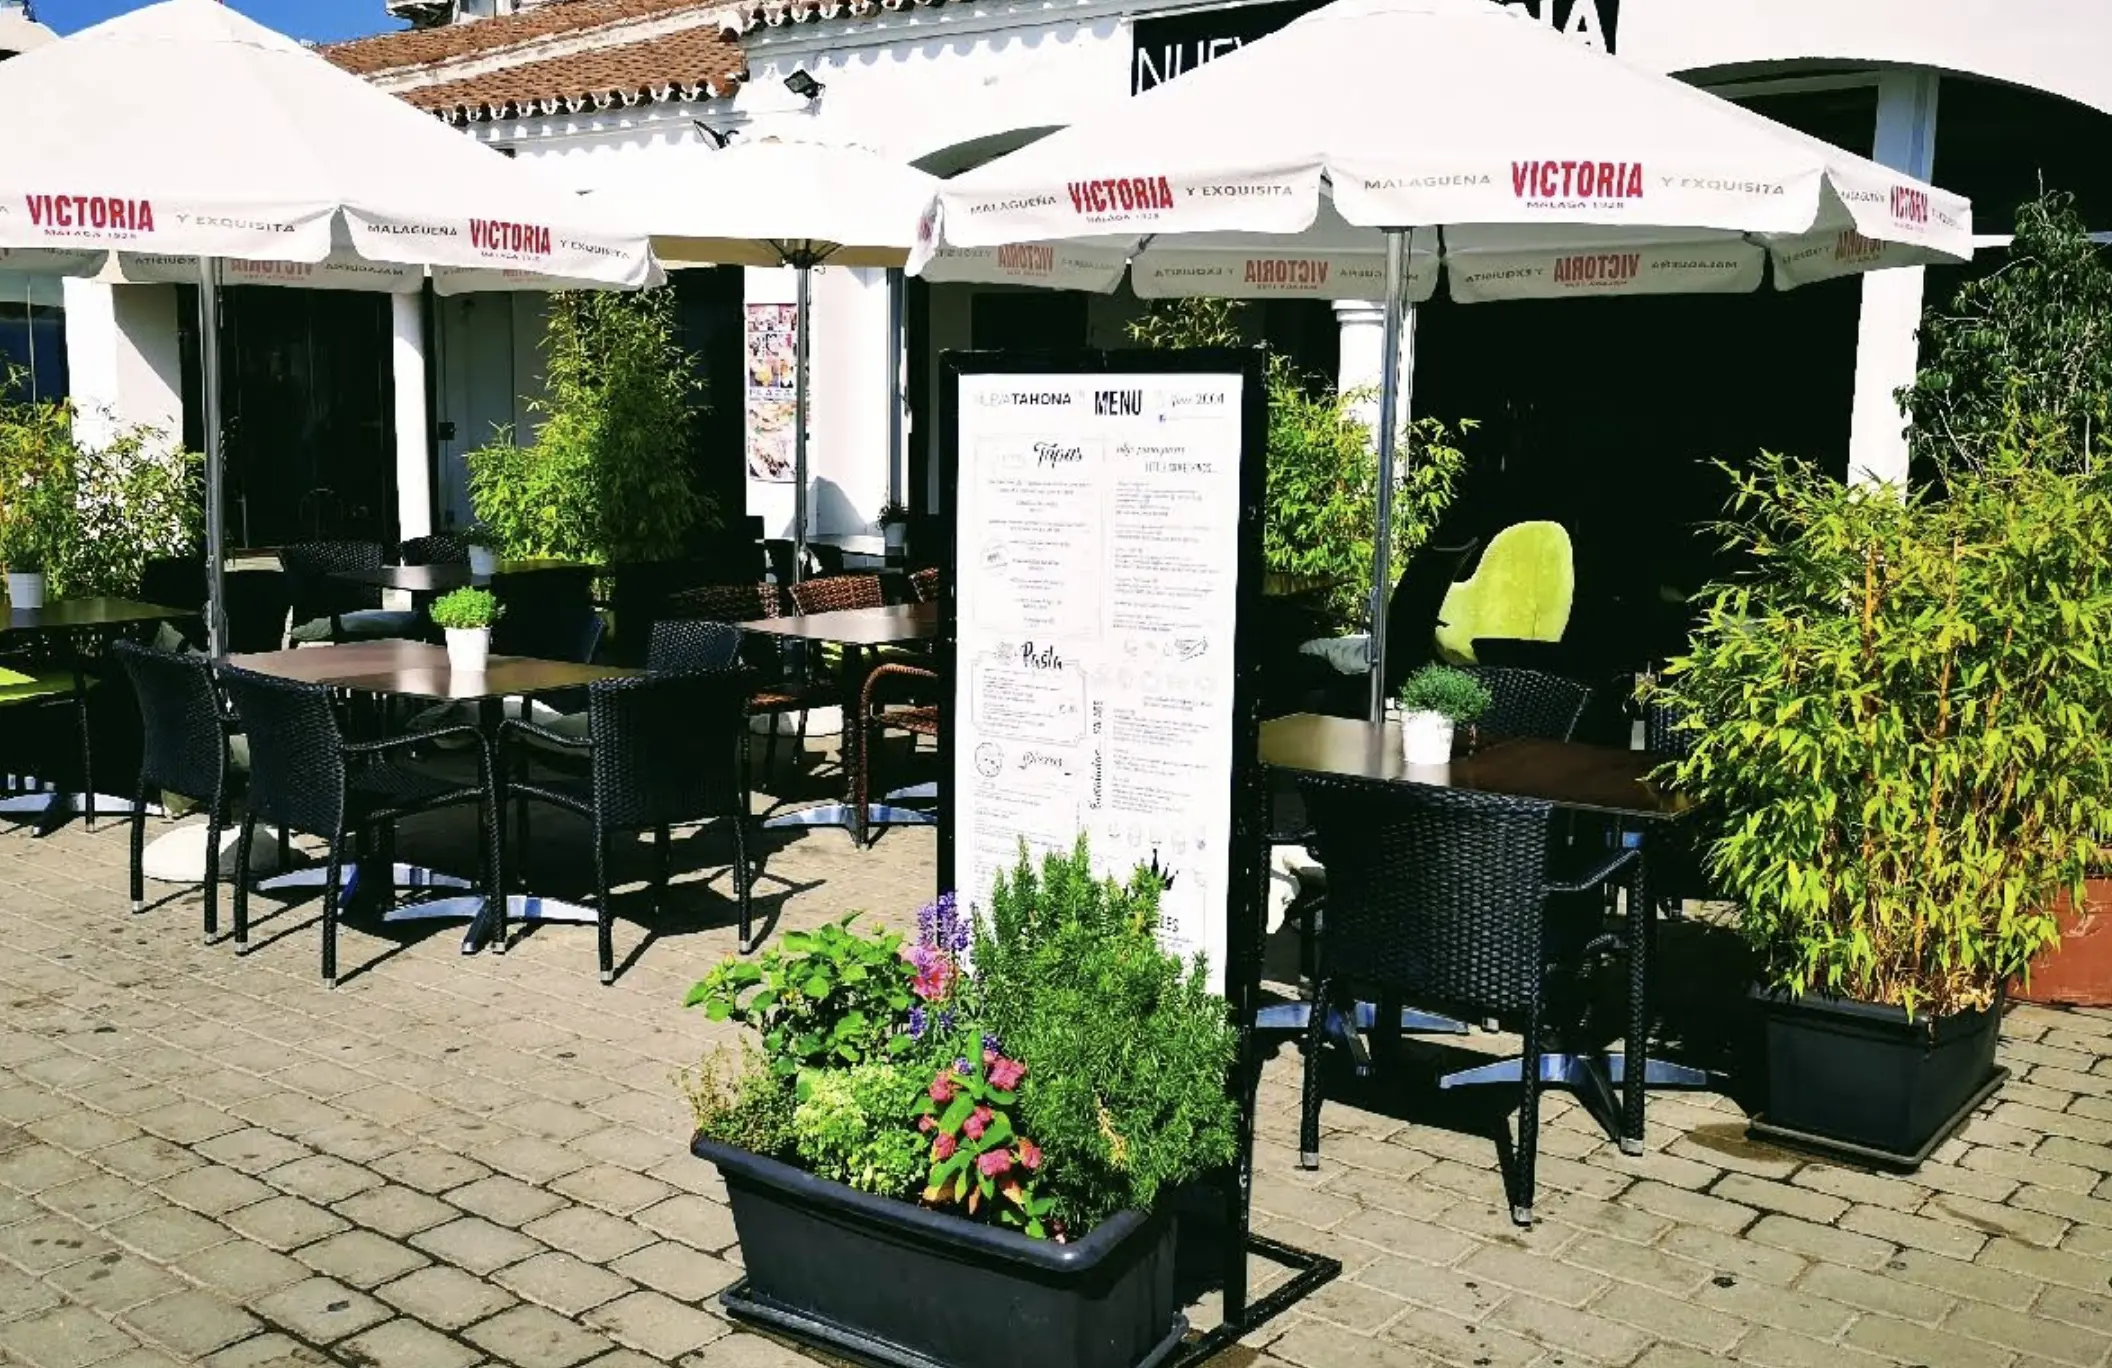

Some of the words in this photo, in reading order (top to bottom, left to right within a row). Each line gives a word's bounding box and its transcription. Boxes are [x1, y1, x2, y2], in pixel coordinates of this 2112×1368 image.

[1067, 176, 1174, 214] VICTORIA
[1185, 186, 1196, 197] Y
[1202, 184, 1293, 197] EXQUISITA
[1511, 161, 1644, 198] VICTORIA
[1662, 177, 1674, 188] Y
[1681, 178, 1784, 195] EXQUISITA
[26, 194, 155, 232] VICTORIA
[176, 214, 190, 224] Y
[196, 215, 295, 233] EXQUISITA
[470, 218, 551, 254] VICTORIA
[560, 239, 567, 248] Y
[571, 241, 631, 260] EXQUISITA
[1095, 389, 1142, 416] MENU
[1021, 641, 1062, 670] Pasta
